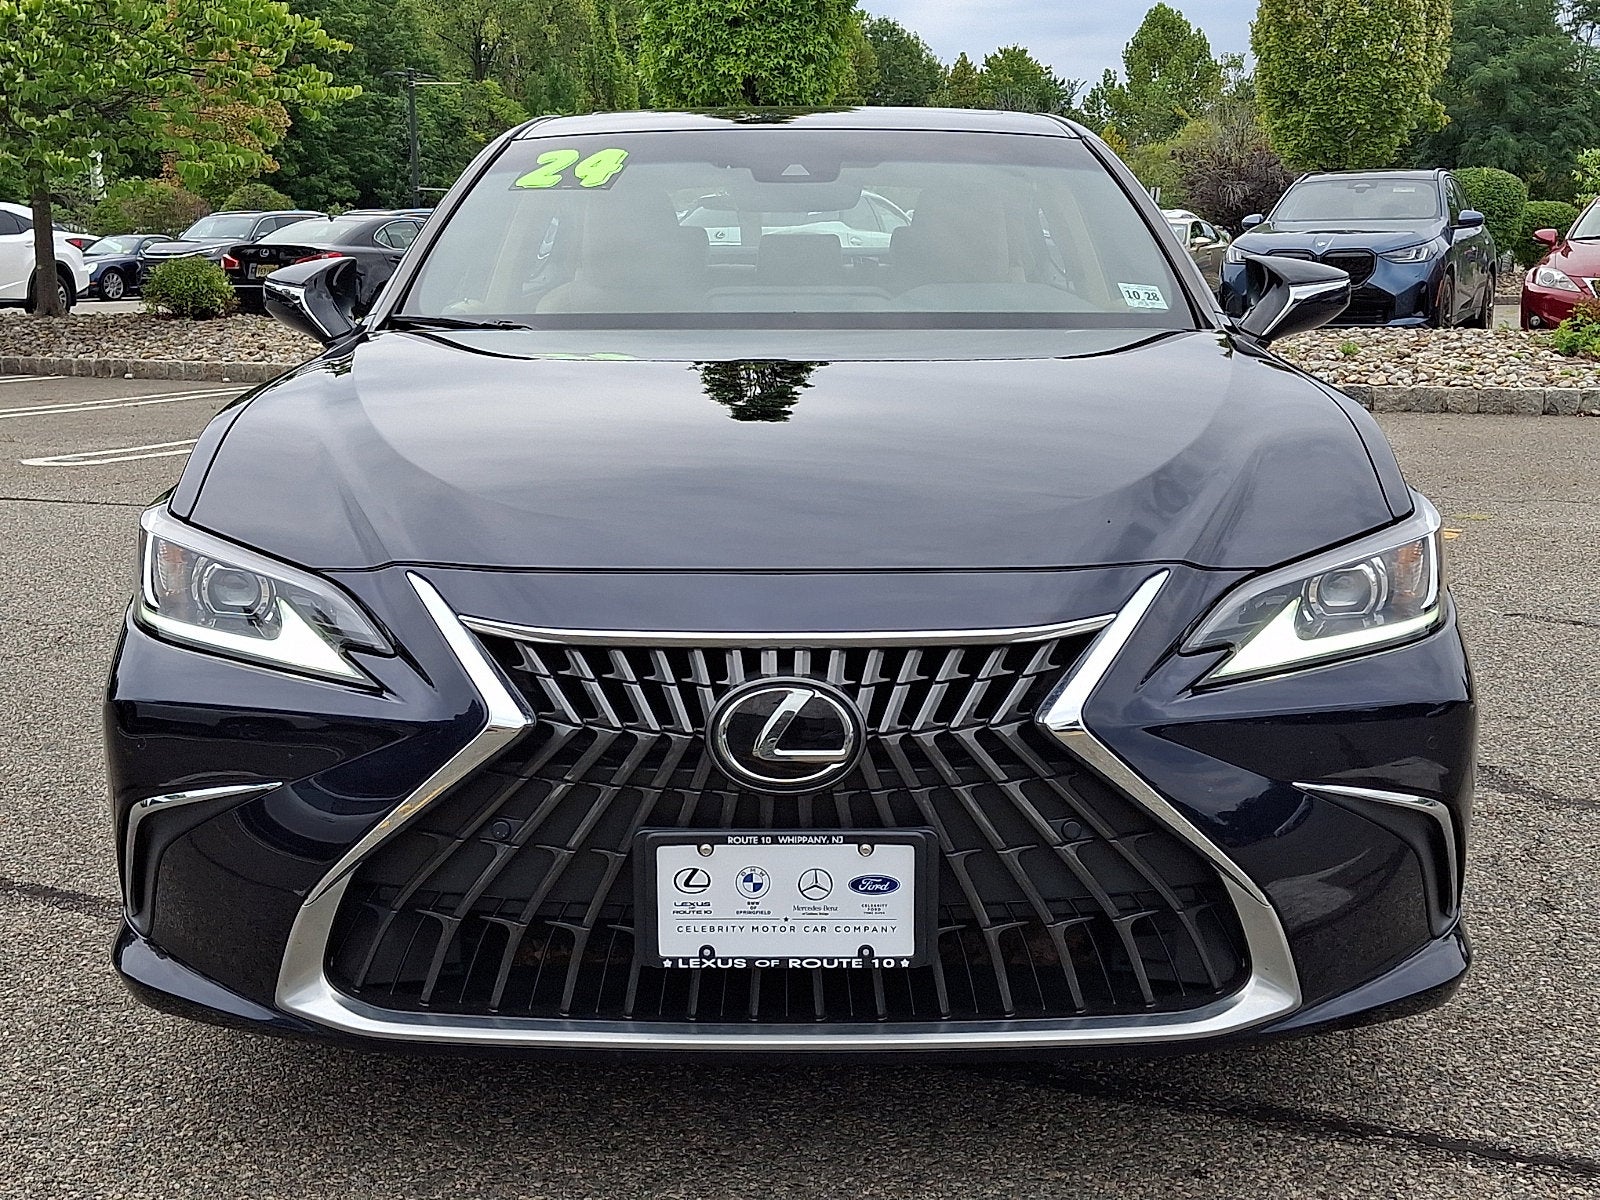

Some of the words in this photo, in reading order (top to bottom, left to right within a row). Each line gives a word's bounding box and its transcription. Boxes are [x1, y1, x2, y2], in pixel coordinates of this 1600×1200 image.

[515, 147, 629, 189] 24
[1125, 290, 1141, 300] 10
[1144, 292, 1160, 302] 28
[727, 836, 758, 844] ROUTE
[761, 836, 772, 844] 10
[778, 836, 830, 844] WHIPPANY,
[831, 836, 844, 844] NJ
[858, 878, 890, 891] Ford
[676, 925, 745, 933] CELEBRITY
[751, 925, 796, 933] MOTOR
[803, 925, 827, 933] CAR
[834, 925, 897, 933] COMPANY
[678, 958, 747, 969] LEXUS
[755, 959, 780, 968] OF
[788, 958, 863, 969] ROUTE
[871, 958, 896, 969] 10
